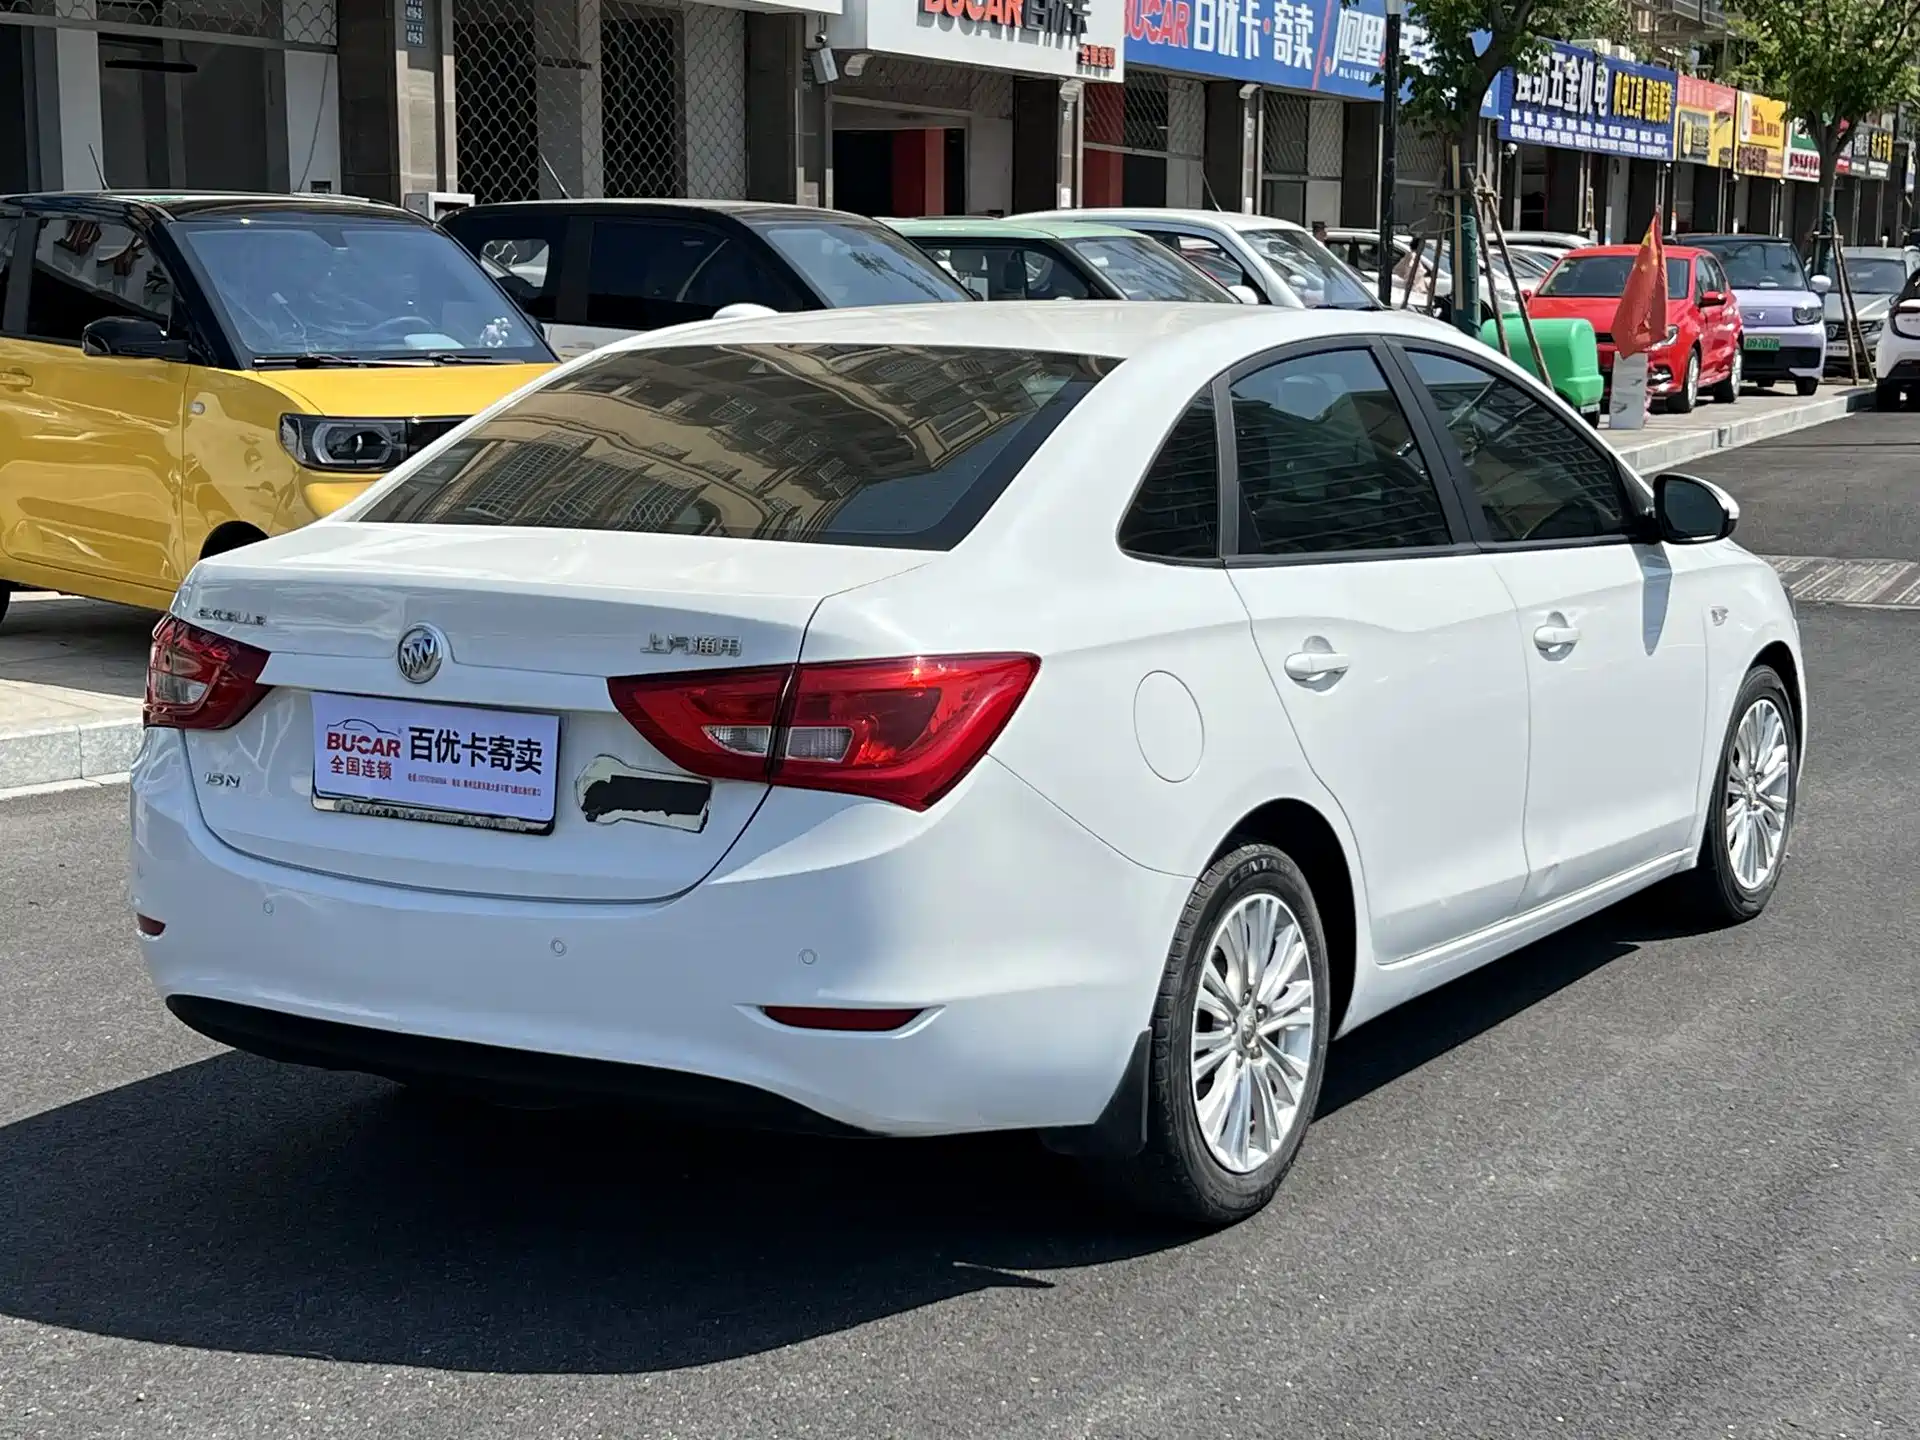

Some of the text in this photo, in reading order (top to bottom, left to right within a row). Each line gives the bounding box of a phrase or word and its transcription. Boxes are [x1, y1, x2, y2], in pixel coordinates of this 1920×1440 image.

[640, 632, 742, 657] 上汽通用
[327, 732, 400, 758] BUCAR
[408, 726, 542, 775] 百优卡寄卖
[330, 755, 393, 781] 全国连锁
